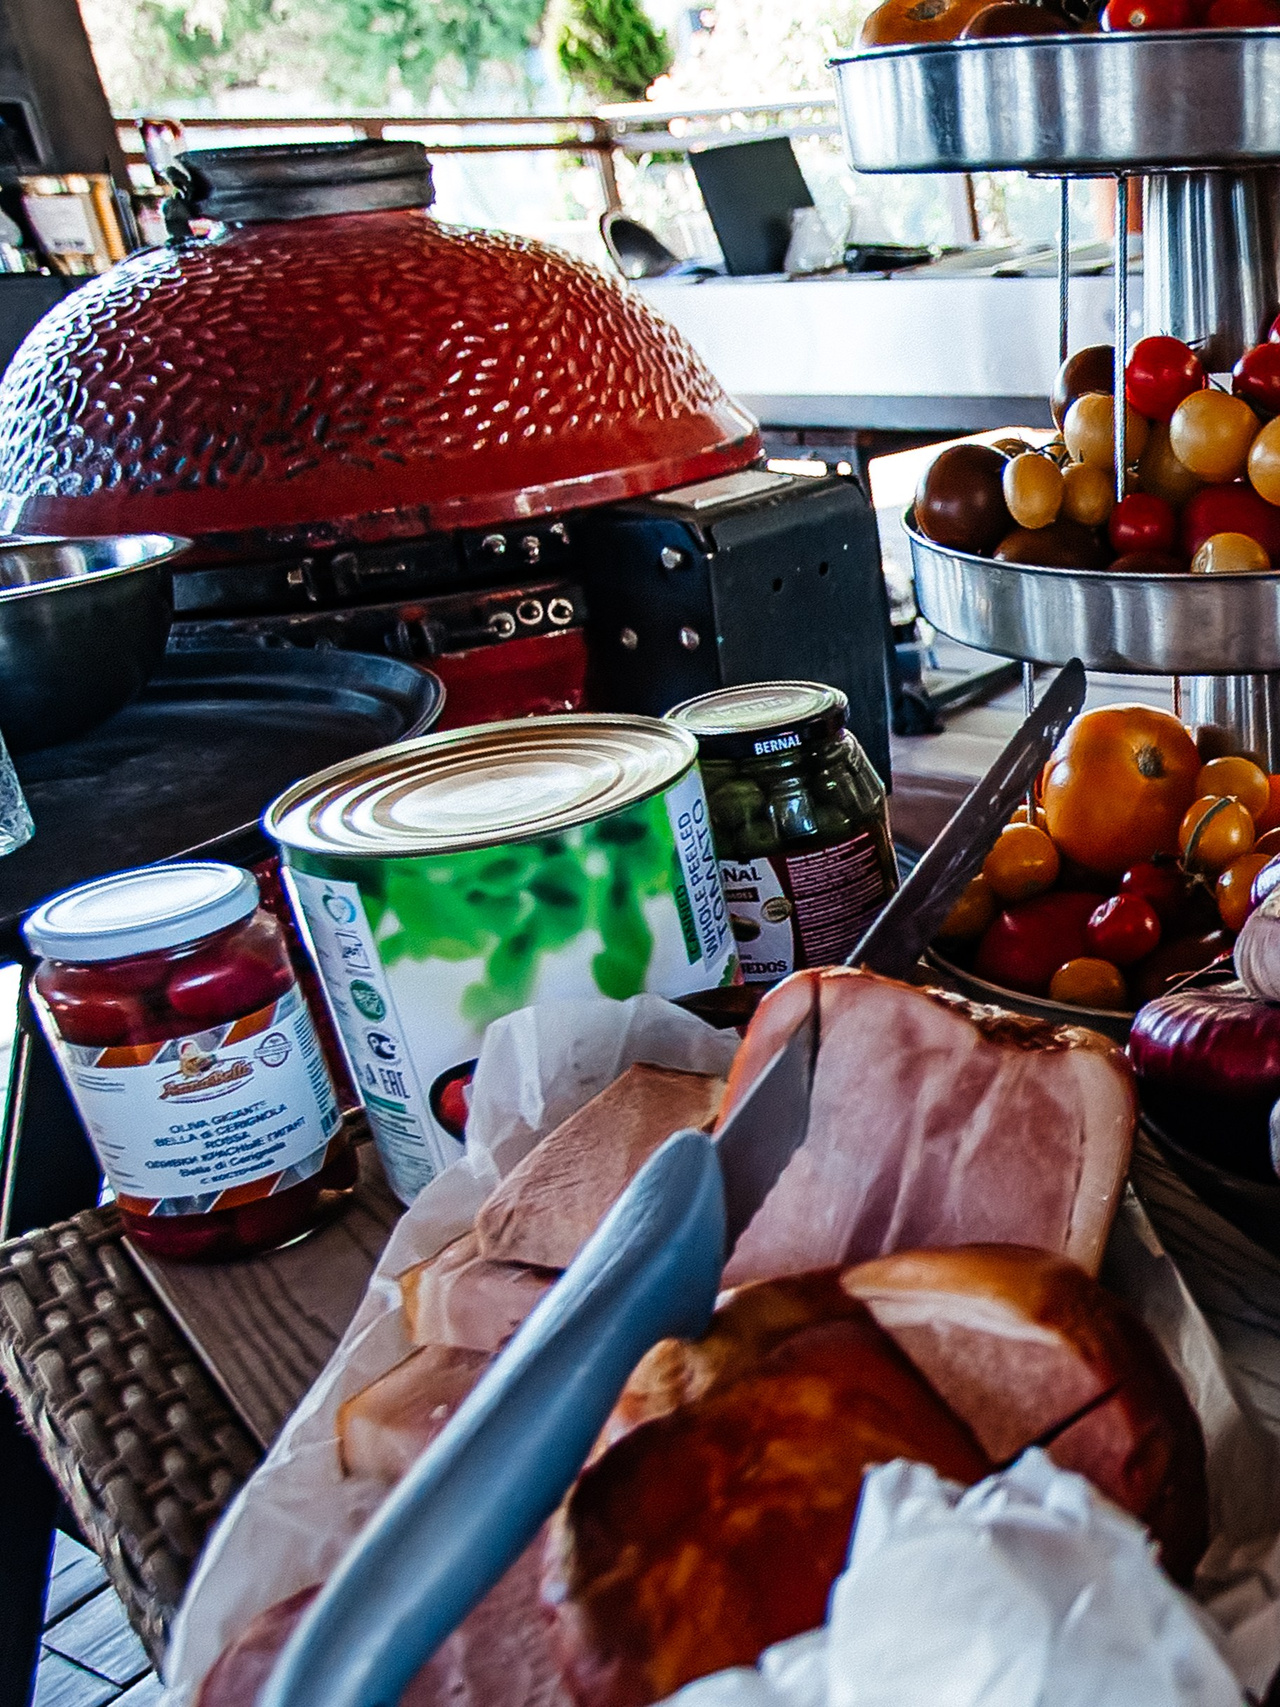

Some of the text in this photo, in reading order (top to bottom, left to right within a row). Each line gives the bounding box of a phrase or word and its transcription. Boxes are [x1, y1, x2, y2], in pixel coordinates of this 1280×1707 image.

[754, 734, 802, 756] BERNAL
[677, 811, 720, 959] WHOLE PEELED
[692, 798, 728, 945] TOMATO
[722, 866, 762, 882] NAL
[676, 884, 698, 955] CANNED
[154, 1133, 198, 1147] BELLA
[215, 1103, 288, 1136] CERIGNOLA
[169, 1119, 209, 1135] OLIVA
[205, 1131, 251, 1149] ROSSA
